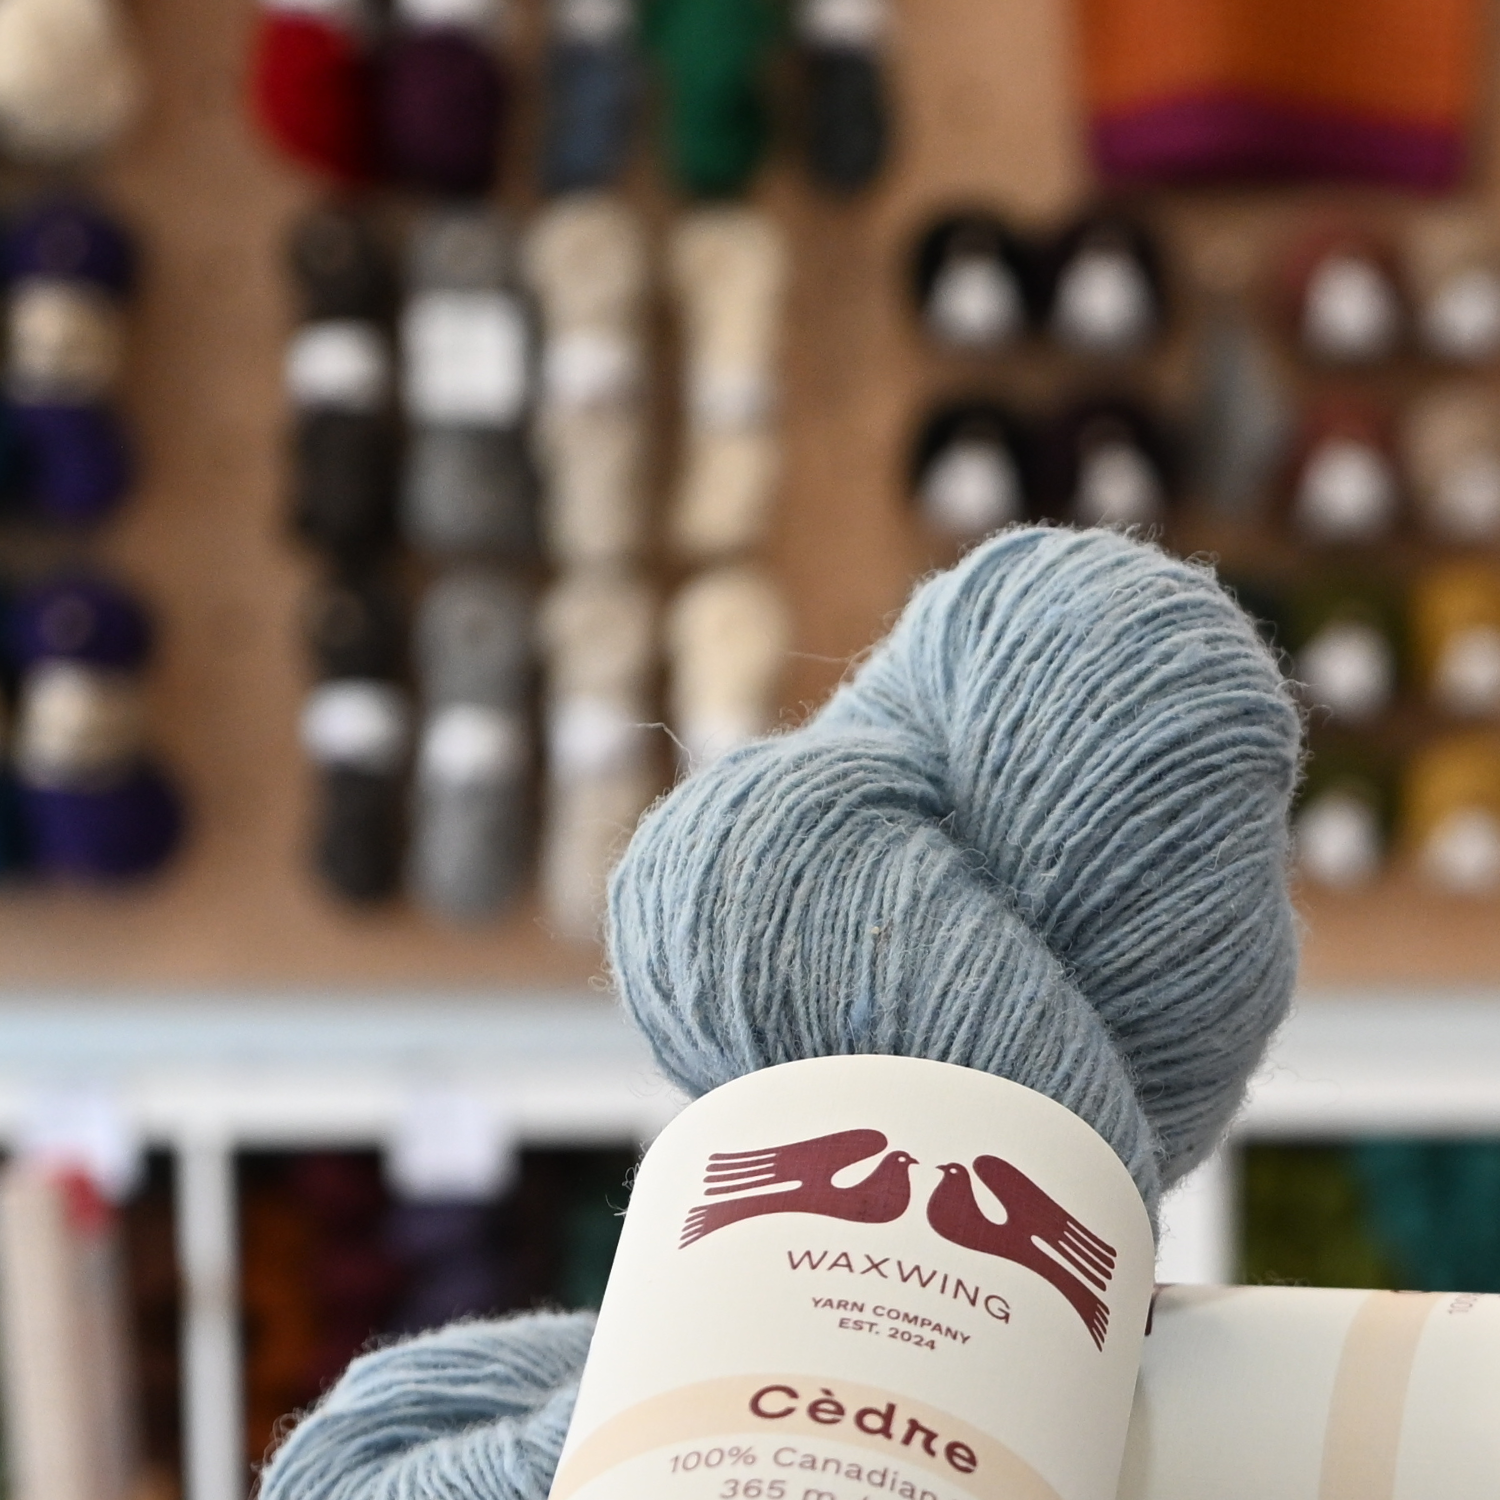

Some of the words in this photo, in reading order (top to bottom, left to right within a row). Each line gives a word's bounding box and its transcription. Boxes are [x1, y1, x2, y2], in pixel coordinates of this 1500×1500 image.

[787, 1250, 1011, 1324] WAXWING
[811, 1297, 865, 1313] YARN
[872, 1305, 971, 1345] COMPANY
[838, 1318, 880, 1335] EST.
[888, 1327, 936, 1350] 2024
[749, 1384, 978, 1474] Cèdre
[669, 1446, 757, 1474] 100%
[719, 1478, 787, 1500] 365
